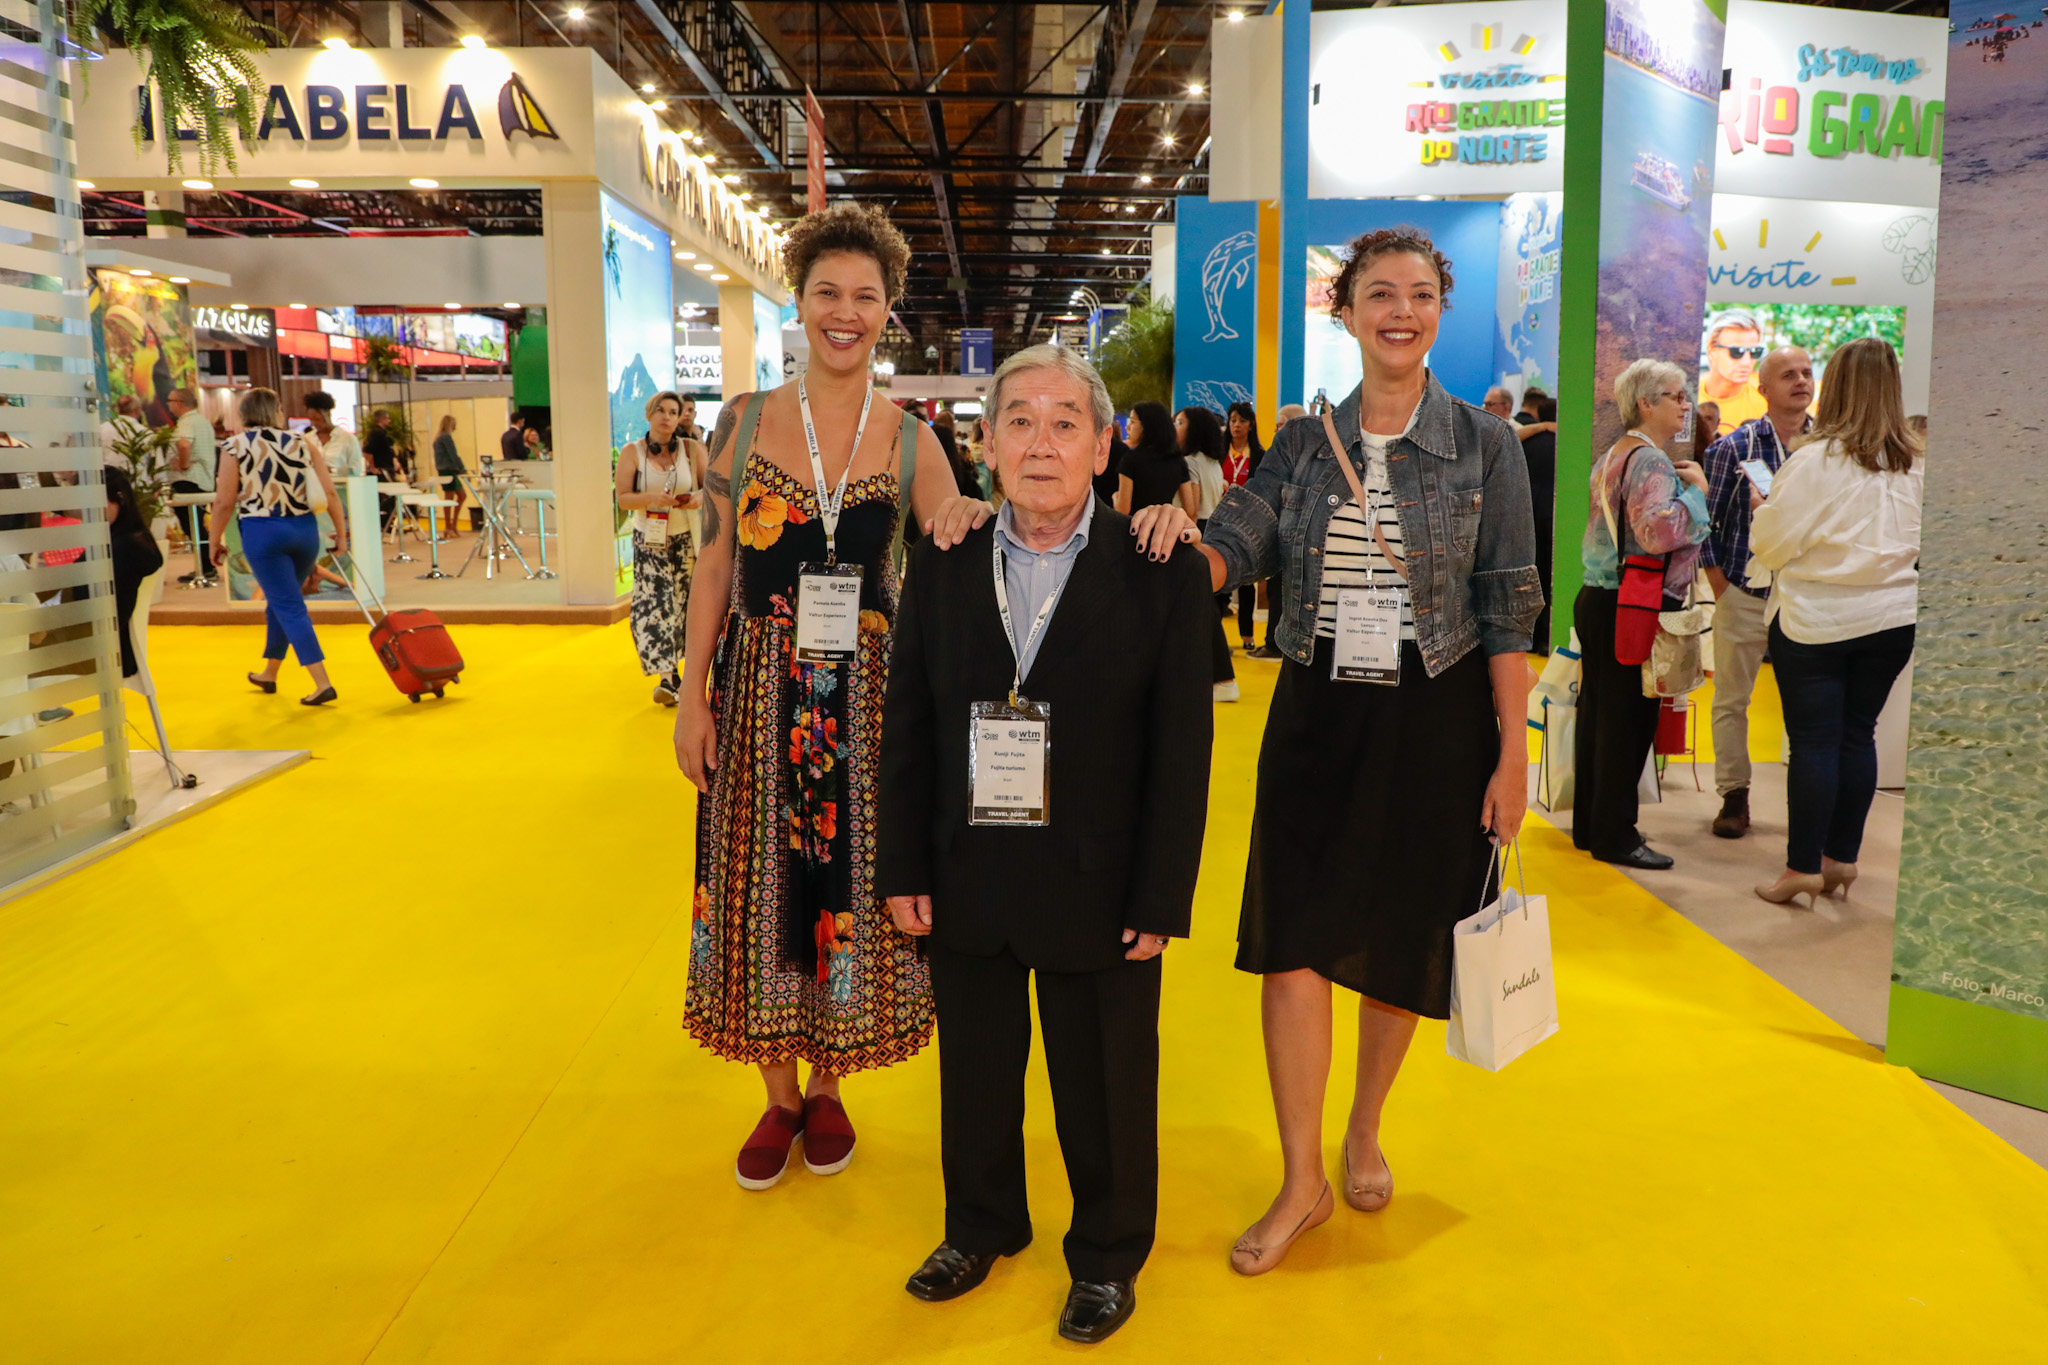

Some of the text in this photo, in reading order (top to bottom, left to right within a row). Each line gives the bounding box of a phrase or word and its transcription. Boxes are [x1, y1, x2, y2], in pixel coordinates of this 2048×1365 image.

[1439, 64, 1539, 91] visite
[138, 84, 483, 141] IABELA
[1458, 98, 1566, 131] GRANDE
[1420, 133, 1548, 164] DO NORTE
[1708, 260, 1821, 288] visite
[968, 347, 986, 374] L
[806, 422, 817, 452] ILHABELA
[817, 480, 829, 510] ILHABELA
[832, 482, 844, 511] ILHABELA
[994, 550, 1002, 582] ILHABELA
[838, 582, 857, 590] wtm
[1377, 598, 1398, 606] wtm
[1018, 729, 1041, 738] wtm
[1502, 967, 1540, 1001] Sandals
[1942, 971, 2045, 1007] Foto: Marco
